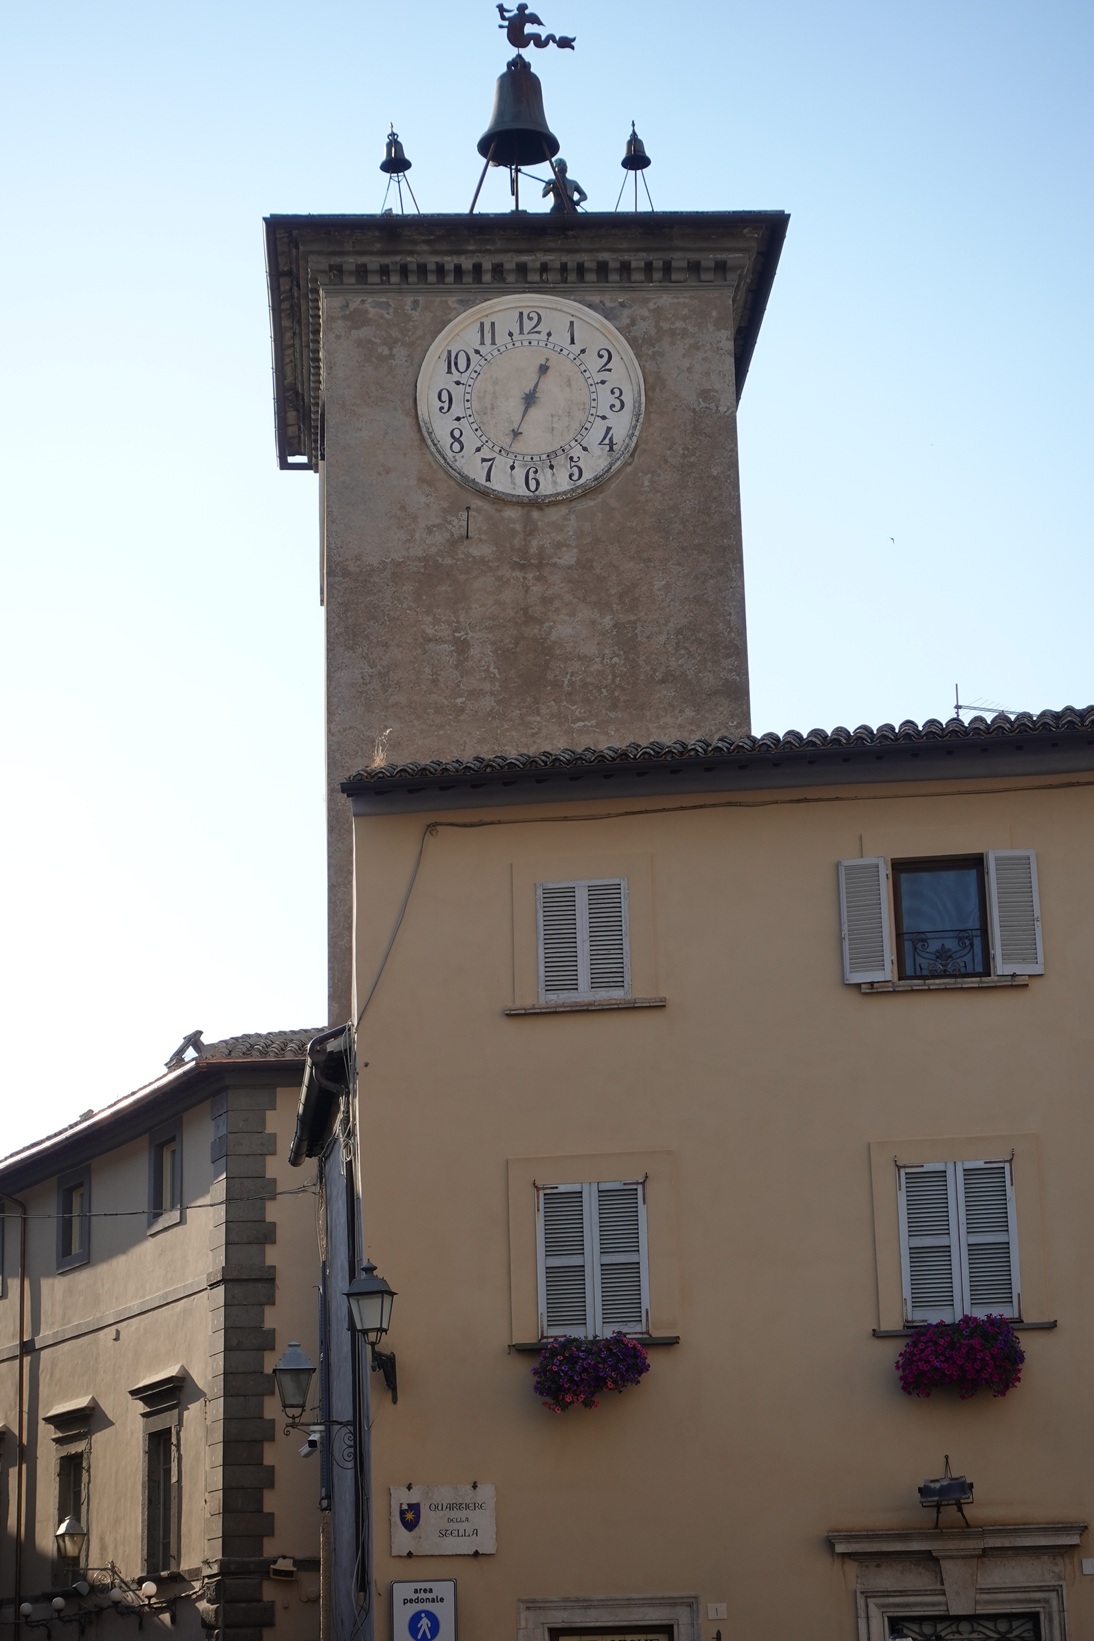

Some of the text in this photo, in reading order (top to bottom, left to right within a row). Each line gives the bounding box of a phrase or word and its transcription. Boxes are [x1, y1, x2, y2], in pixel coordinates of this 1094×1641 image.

[477, 321, 497, 345] 11
[516, 310, 542, 336] 12
[567, 320, 575, 345] 1
[444, 349, 471, 374] 10
[597, 348, 613, 373] 2
[437, 388, 453, 414] 9
[609, 387, 625, 412] 3
[450, 428, 464, 453] 8
[598, 426, 617, 452] 4
[481, 457, 496, 483] 7
[524, 466, 540, 493] 6
[568, 455, 583, 482] 5
[429, 1502, 487, 1512] QUARTIERE
[438, 1528, 479, 1538] STELLA
[403, 1596, 445, 1605] pedonale
